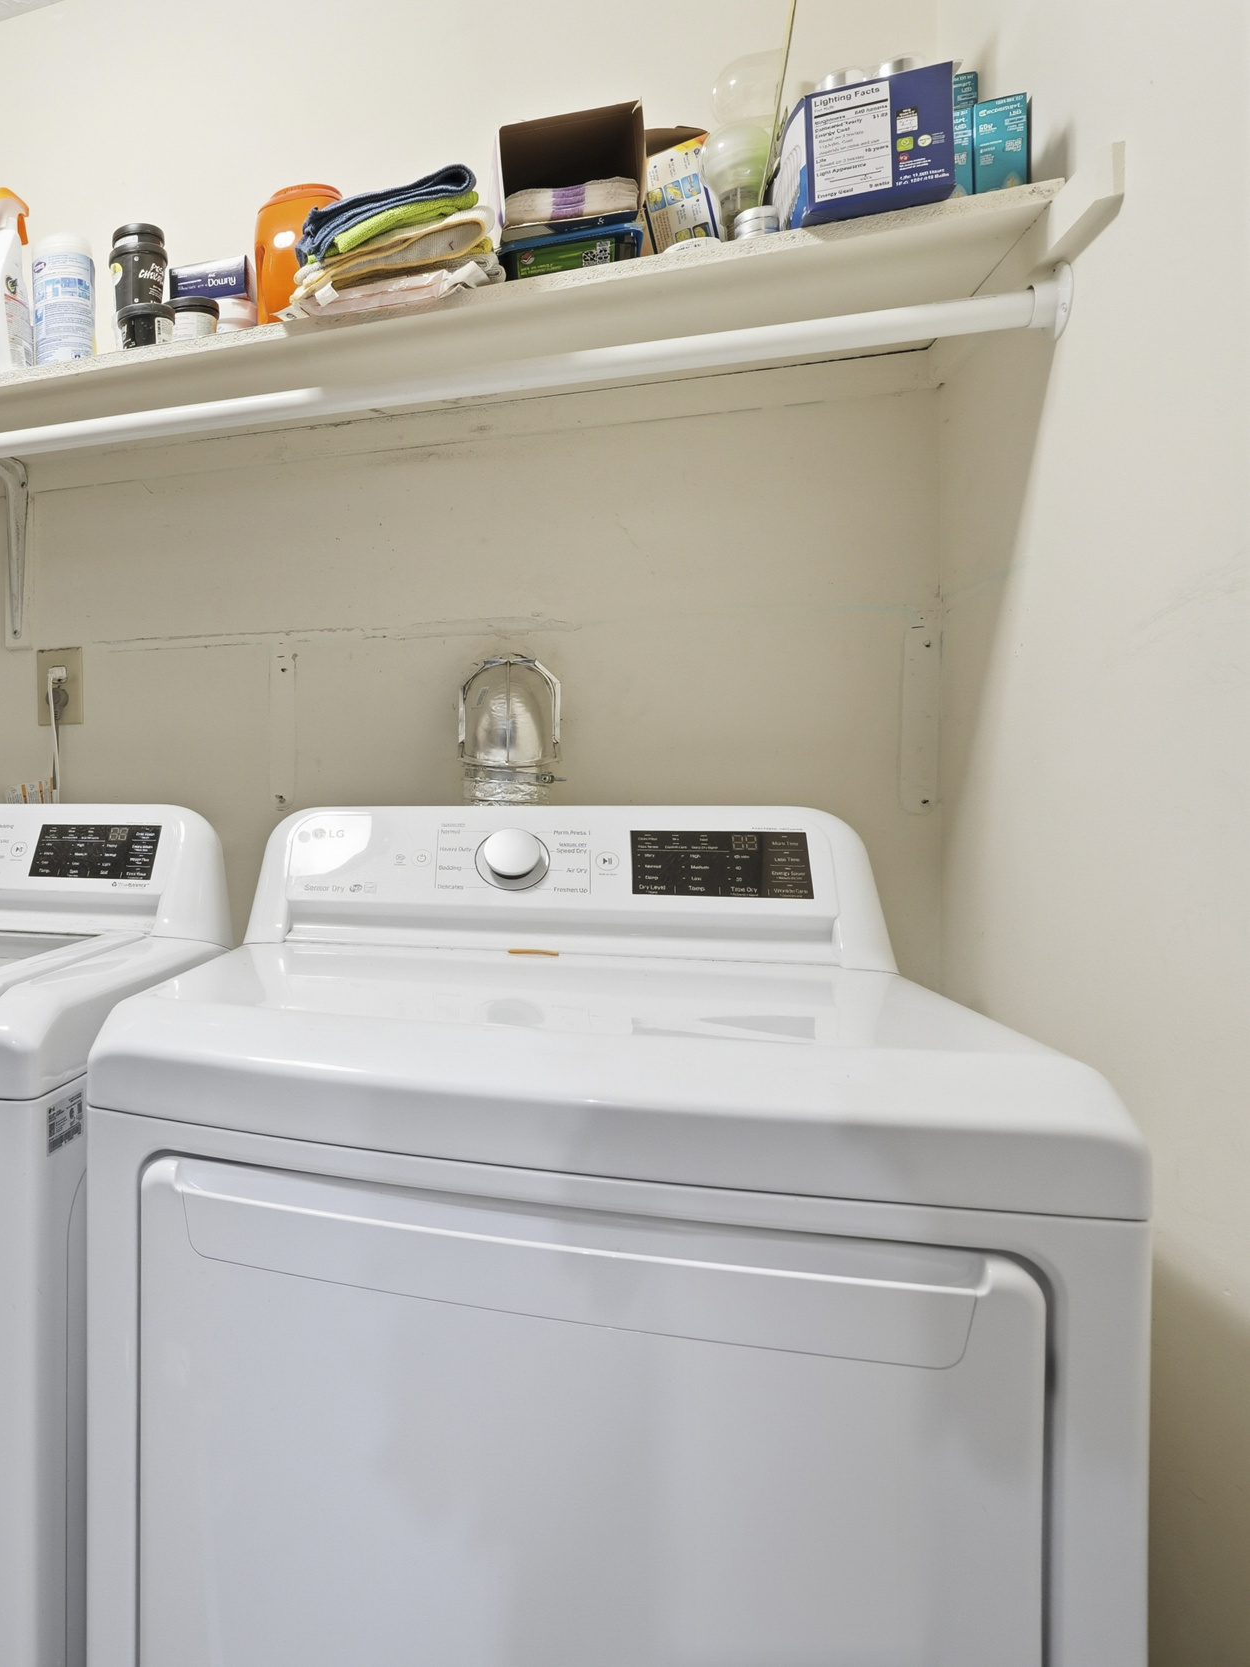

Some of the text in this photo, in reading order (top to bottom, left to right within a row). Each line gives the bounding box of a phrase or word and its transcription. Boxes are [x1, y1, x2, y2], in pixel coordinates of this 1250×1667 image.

[814, 87, 880, 107] Lighting Facts
[207, 275, 236, 288] Downy
[329, 829, 345, 838] LG
[304, 884, 346, 893] Sensor Dry
[746, 886, 758, 894] Dry
